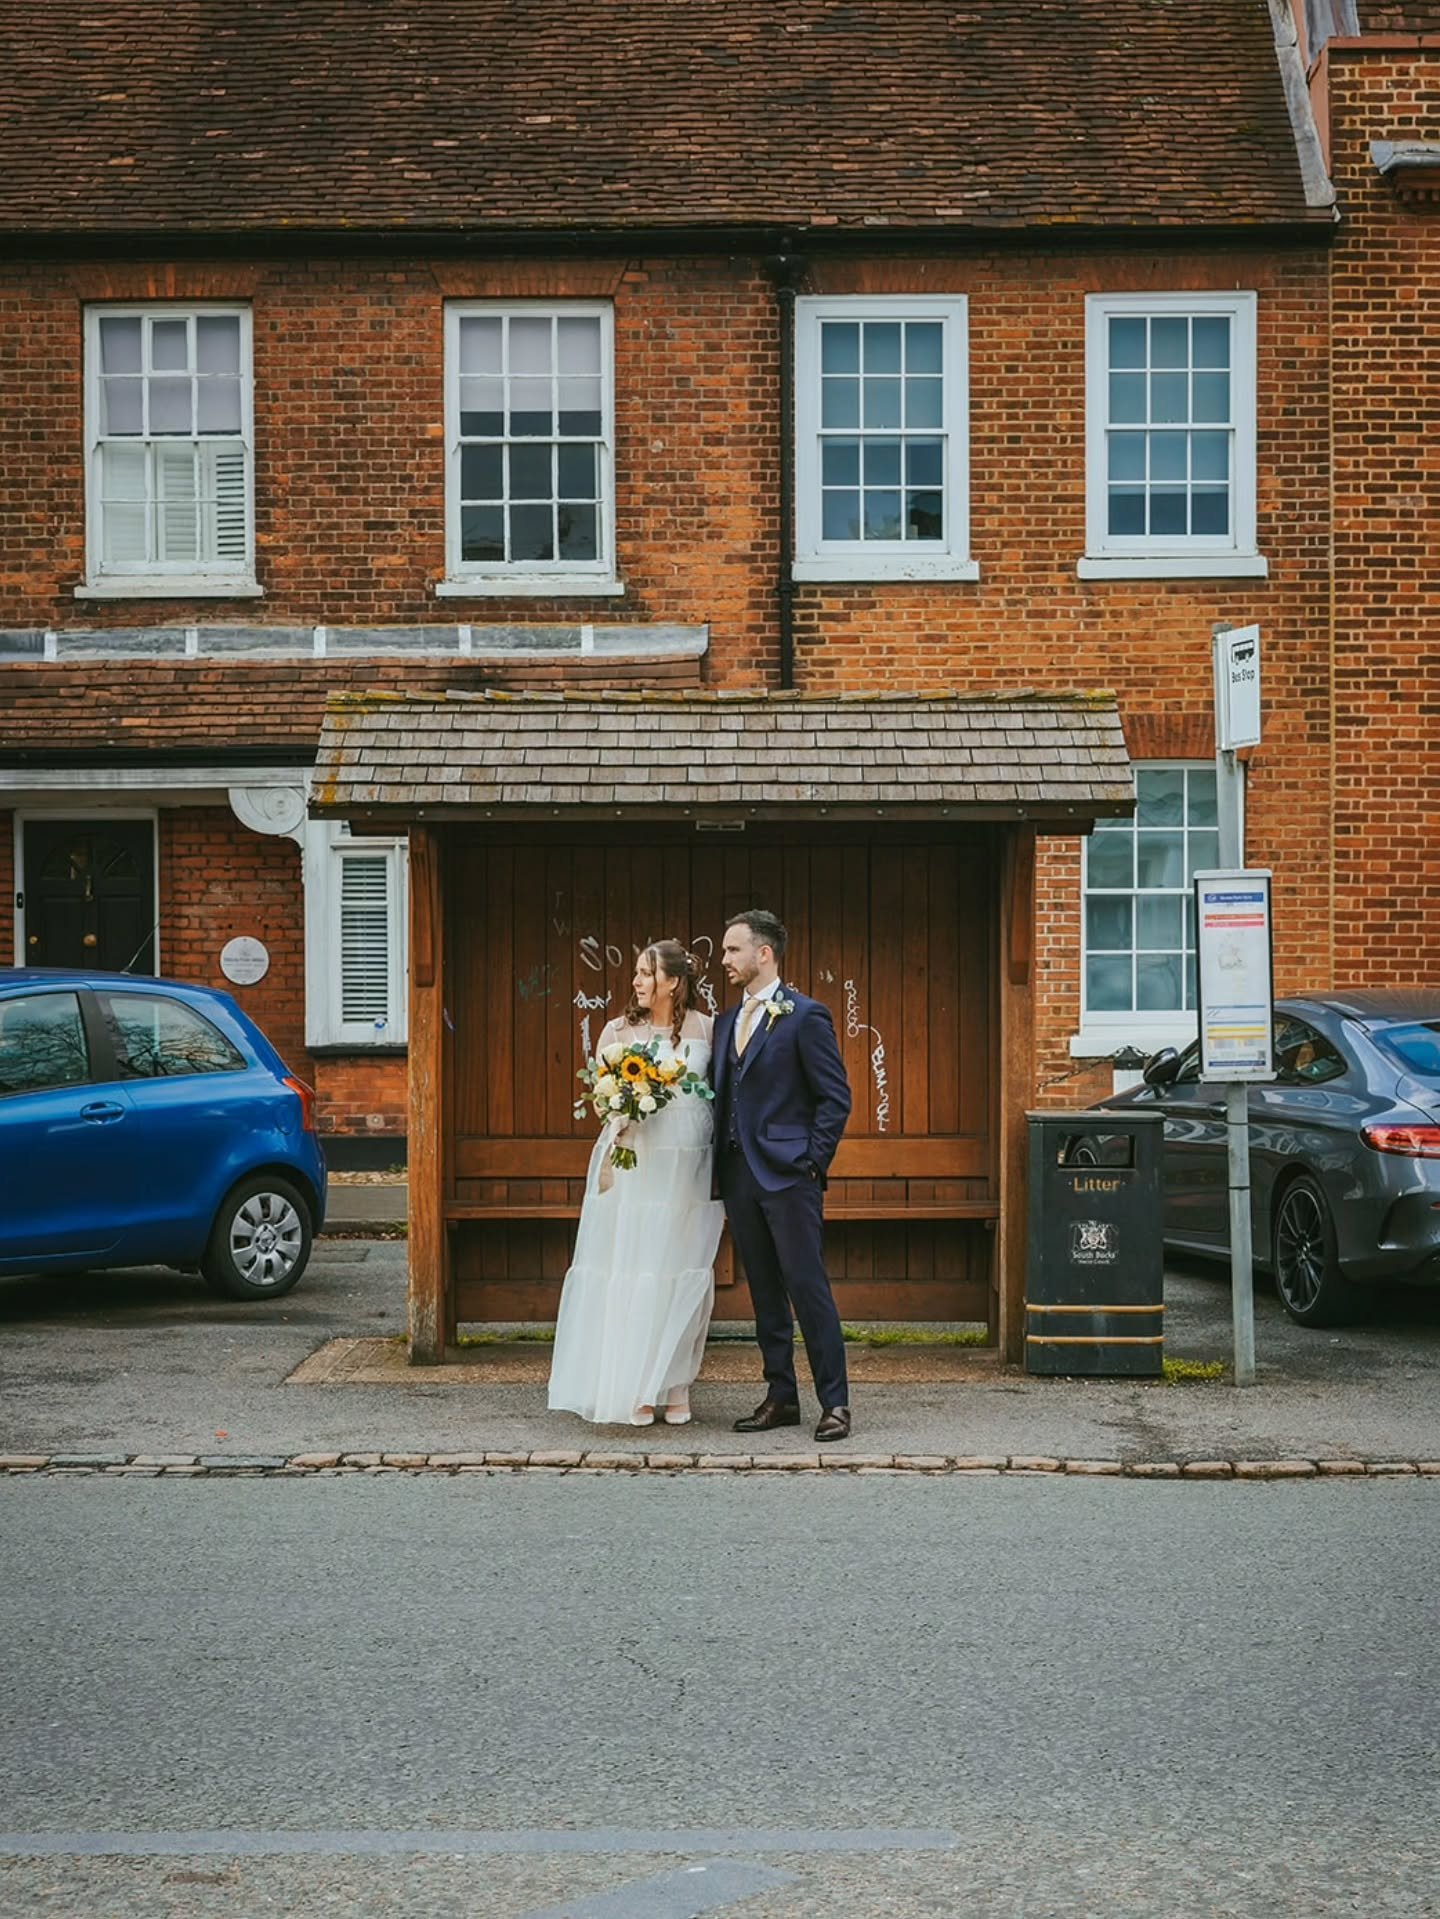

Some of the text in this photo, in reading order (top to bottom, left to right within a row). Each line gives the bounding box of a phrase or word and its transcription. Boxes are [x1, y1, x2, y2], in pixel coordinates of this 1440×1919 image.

[1231, 669, 1255, 683] Bus Stop
[1074, 1177, 1121, 1192] Litter
[1072, 1251, 1094, 1259] South
